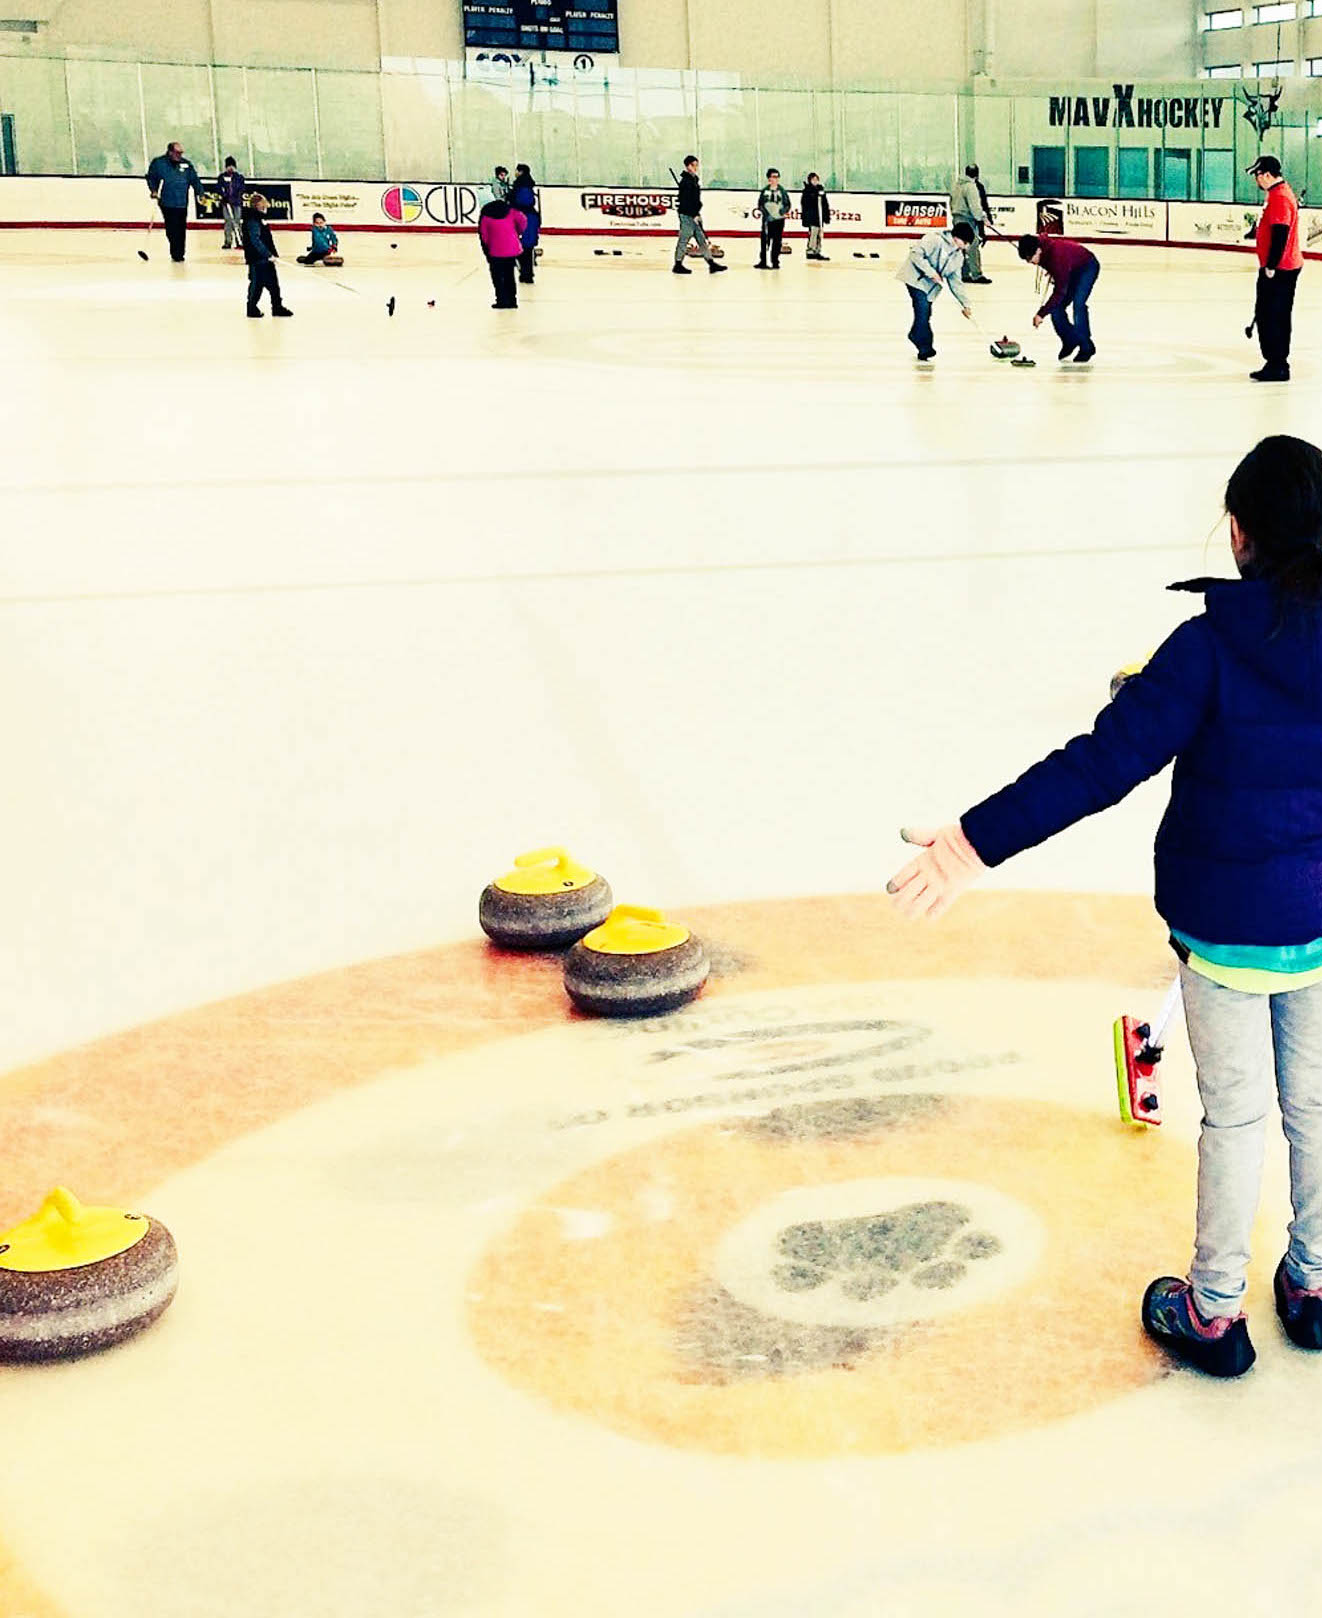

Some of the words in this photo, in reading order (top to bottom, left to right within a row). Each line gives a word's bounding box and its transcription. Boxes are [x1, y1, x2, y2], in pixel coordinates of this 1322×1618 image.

[615, 206, 653, 217] SUBS
[829, 209, 862, 221] Pizza
[895, 202, 944, 218] Jensen
[1066, 203, 1118, 218] BEACON
